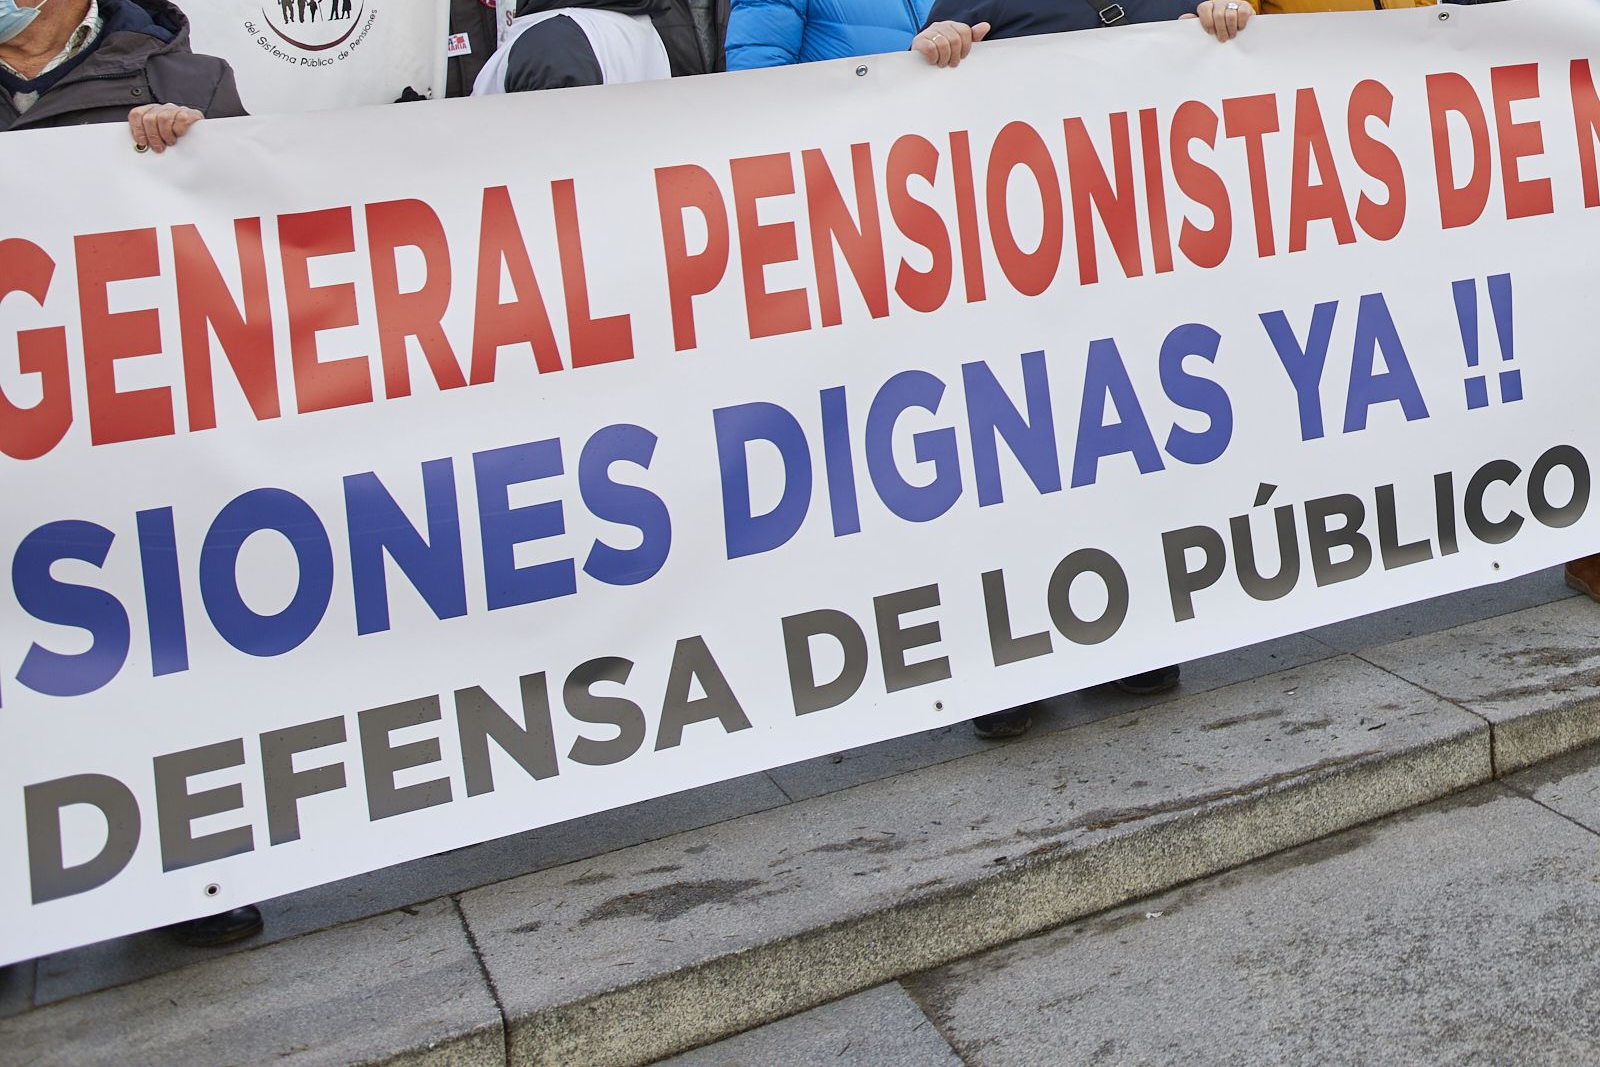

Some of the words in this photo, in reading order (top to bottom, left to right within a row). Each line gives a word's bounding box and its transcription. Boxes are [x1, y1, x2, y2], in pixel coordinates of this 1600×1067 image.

[244, 21, 258, 36] del
[257, 36, 297, 65] Sistema
[338, 50, 349, 61] de
[350, 9, 378, 50] Pensiones
[0, 178, 634, 461] GENERAL
[654, 79, 1407, 352] PENSIONISTAS
[1426, 62, 1555, 229] DE
[12, 423, 672, 697] SIONES
[712, 323, 1233, 560] DIGNAS
[1258, 293, 1430, 441] YA
[1451, 272, 1524, 410] !!
[24, 635, 752, 905] DEFENSA
[781, 583, 952, 716] DE
[981, 548, 1129, 667] LO
[1161, 444, 1591, 623] PÚBLICO
